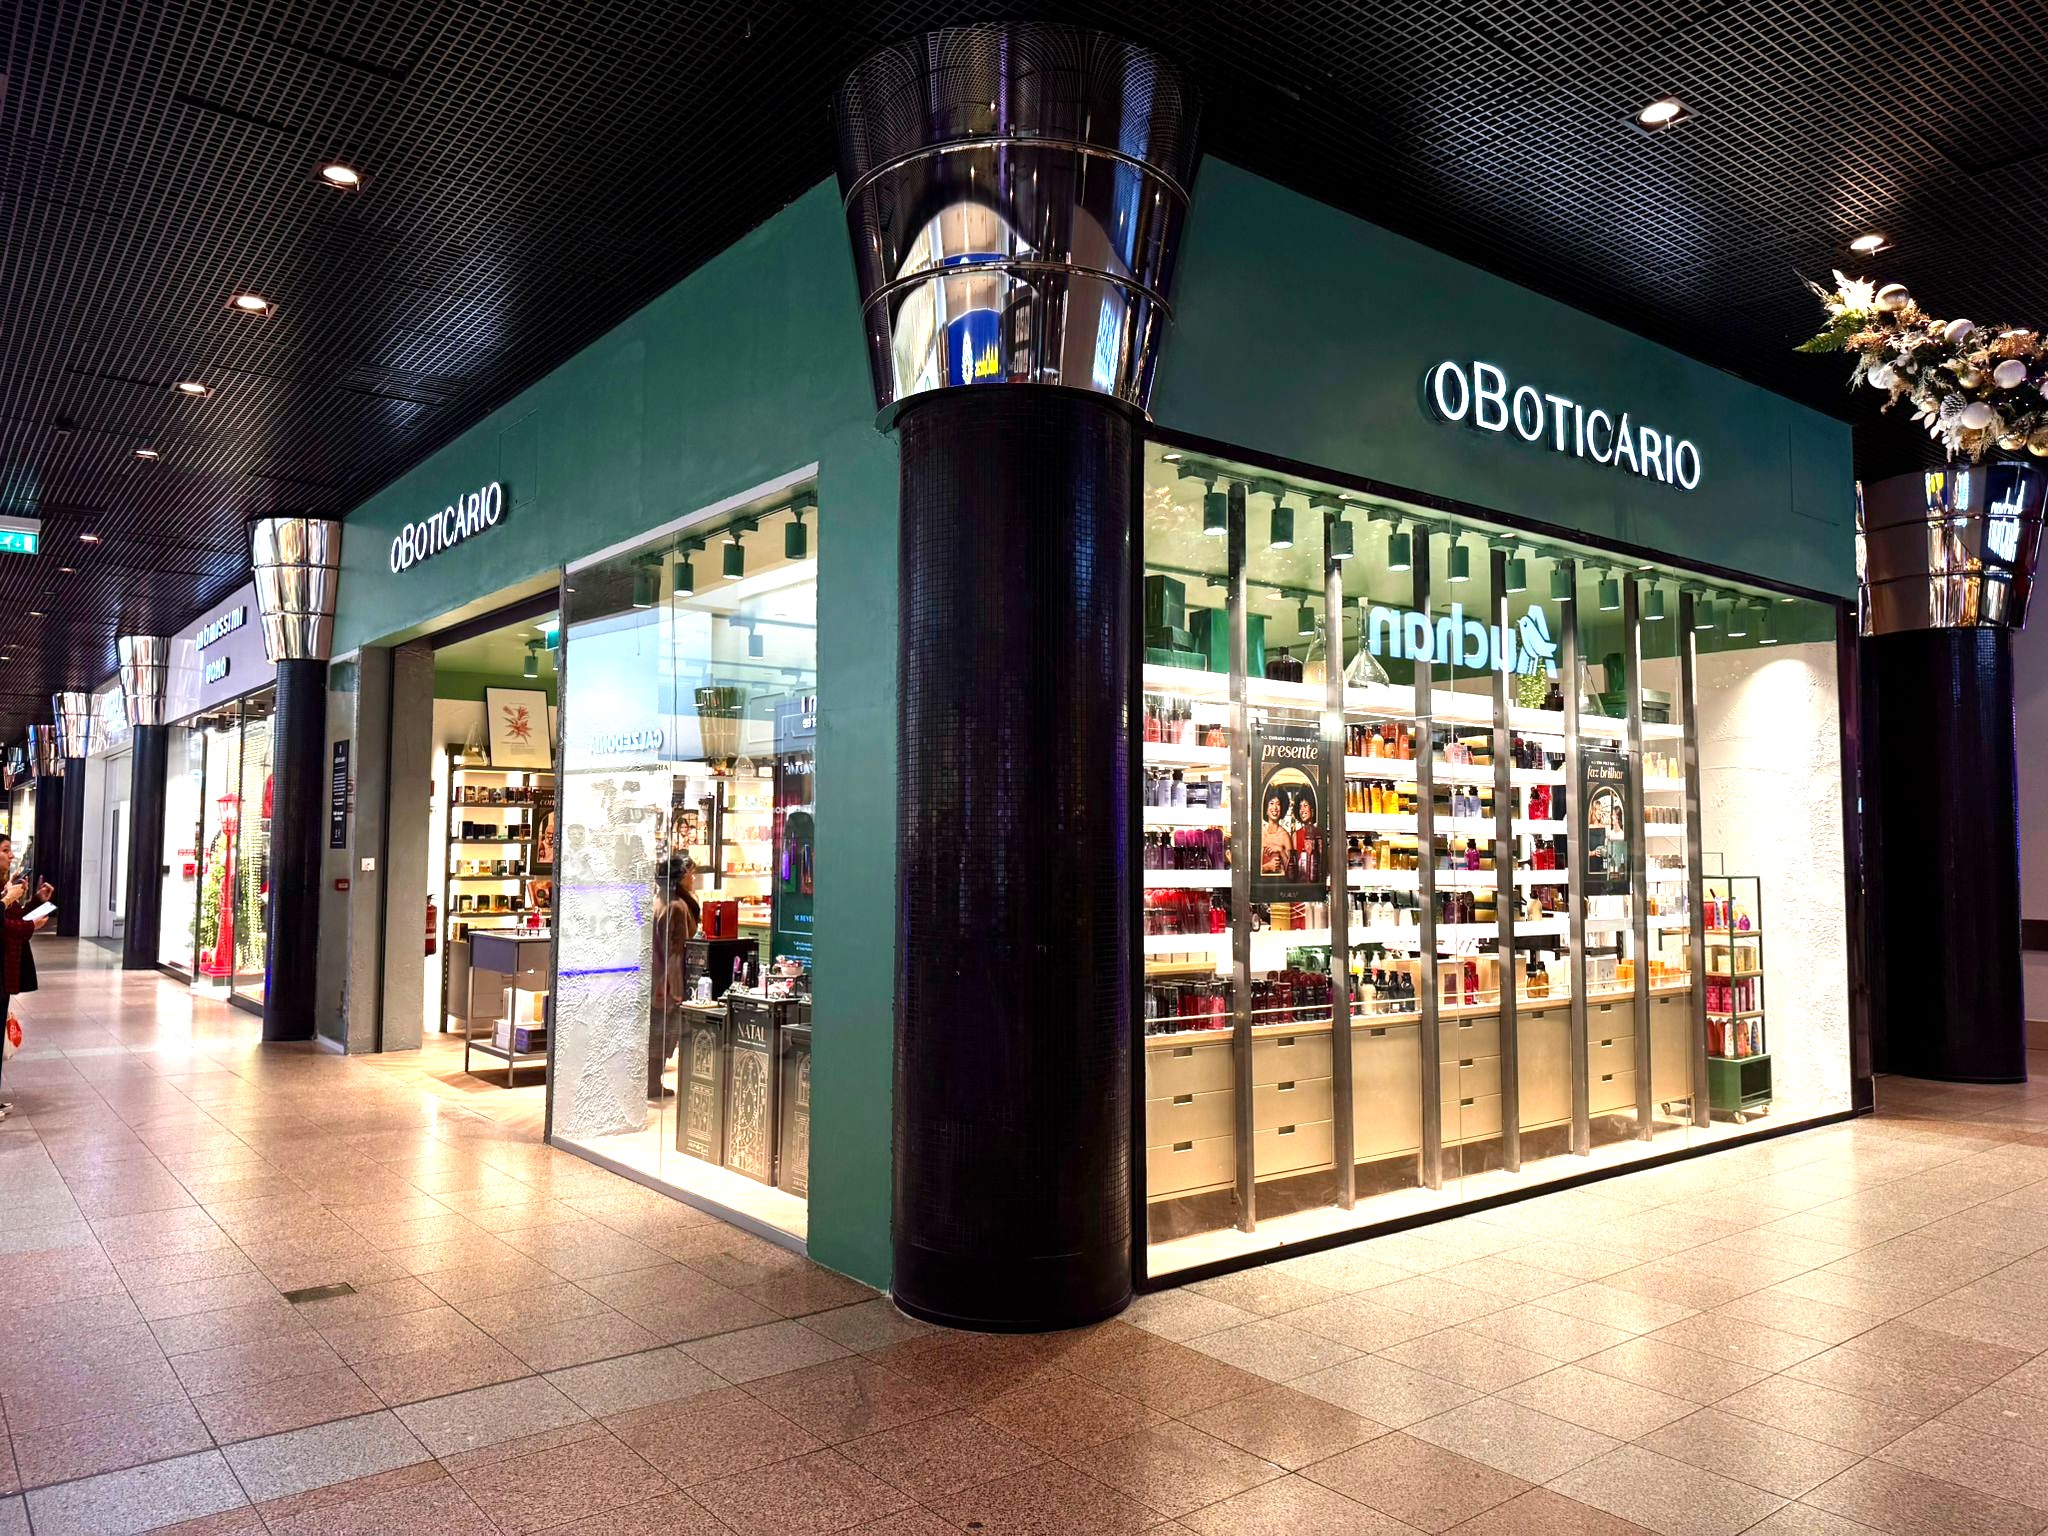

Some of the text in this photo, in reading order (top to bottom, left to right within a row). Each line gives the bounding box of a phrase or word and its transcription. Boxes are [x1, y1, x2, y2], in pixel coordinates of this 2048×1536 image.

[1262, 744, 1319, 760] presente
[1600, 766, 1625, 780] brilhar
[737, 1021, 767, 1042] NATAL
